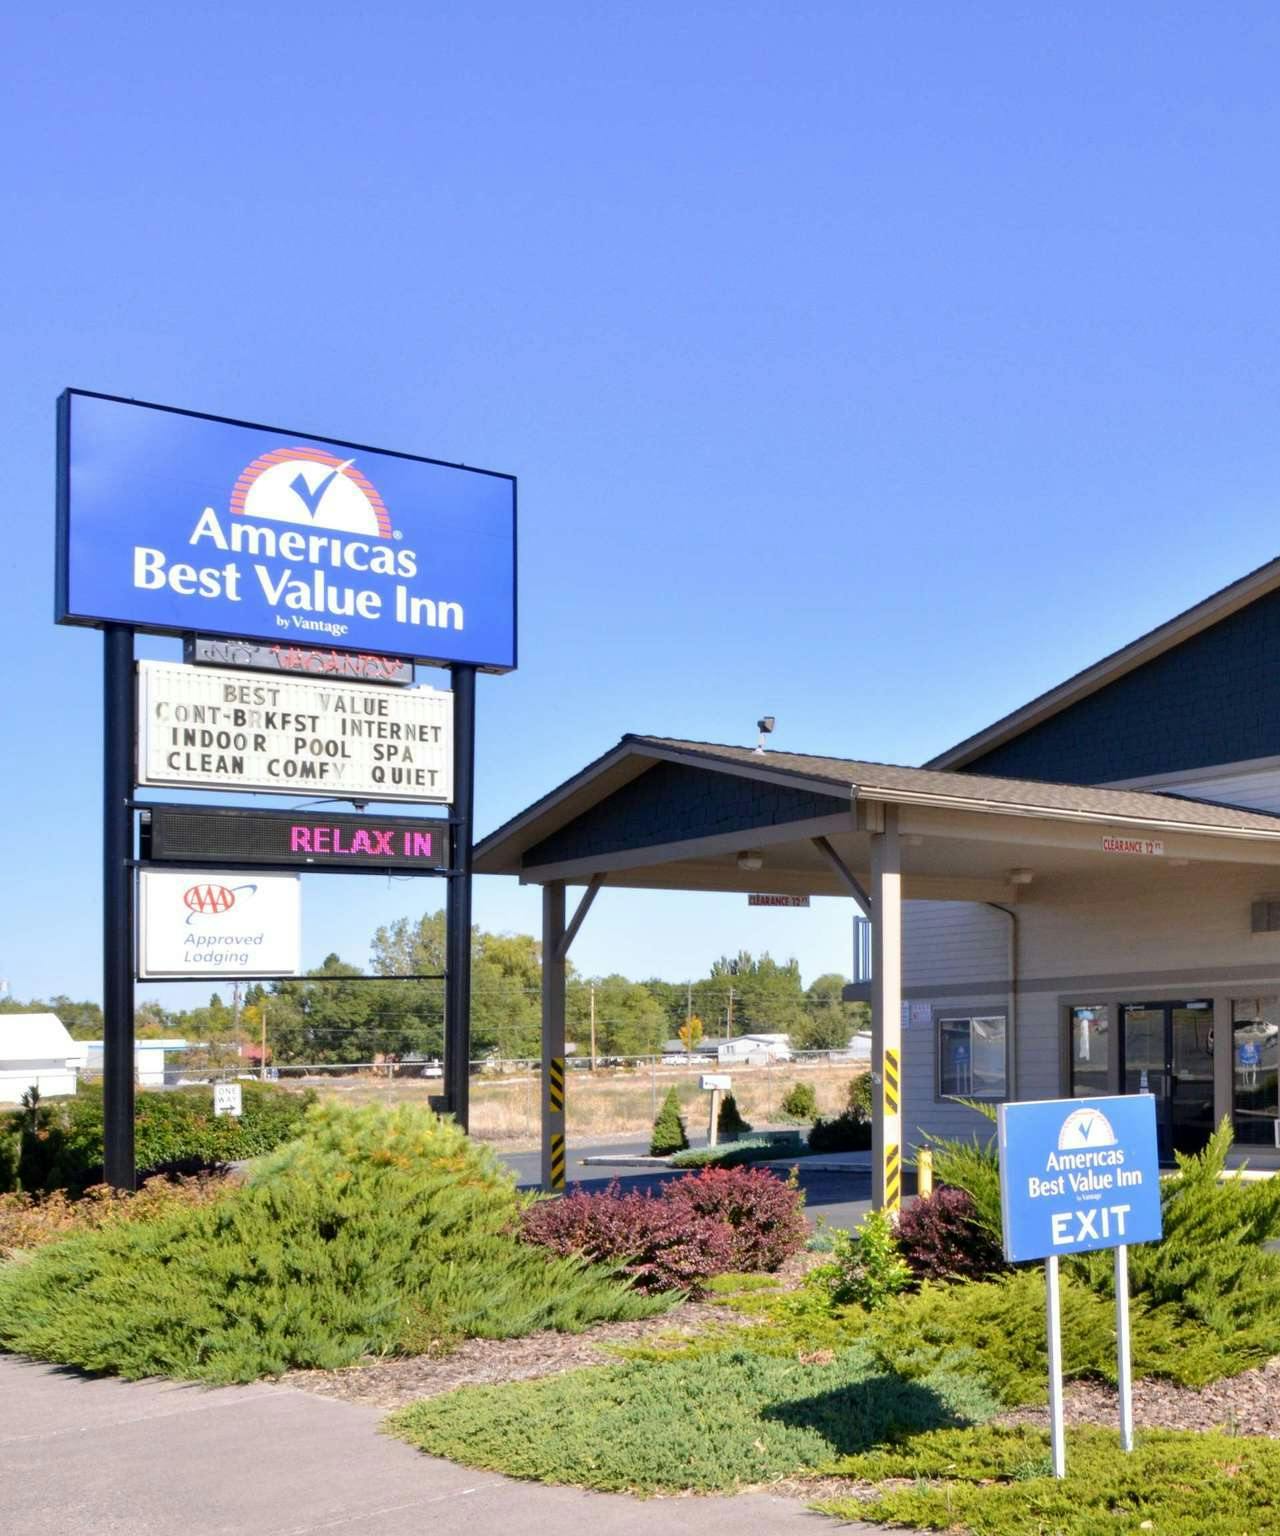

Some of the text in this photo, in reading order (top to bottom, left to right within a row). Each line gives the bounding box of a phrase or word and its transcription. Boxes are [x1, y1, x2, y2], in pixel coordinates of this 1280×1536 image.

[189, 507, 417, 578] Americas
[134, 546, 465, 630] Best Value Inn
[276, 615, 349, 635] by Vantage
[223, 684, 389, 716] BEST VALUE
[156, 701, 441, 743] CONT-BRKFST INTERNET
[172, 727, 413, 763] INDOOR POOL SPA
[167, 751, 439, 786] CLEAN COMFY QUIET
[291, 825, 431, 857] RELAX IN
[1103, 838, 1142, 853] CLEARANCE
[184, 884, 233, 914] AAA
[184, 932, 264, 949] Approved
[184, 950, 249, 966] Lodging
[218, 1087, 237, 1095] ONE
[1046, 1149, 1124, 1172] Americas
[1028, 1168, 1142, 1198] Best Value Inn
[1051, 1204, 1131, 1246] EXIT
